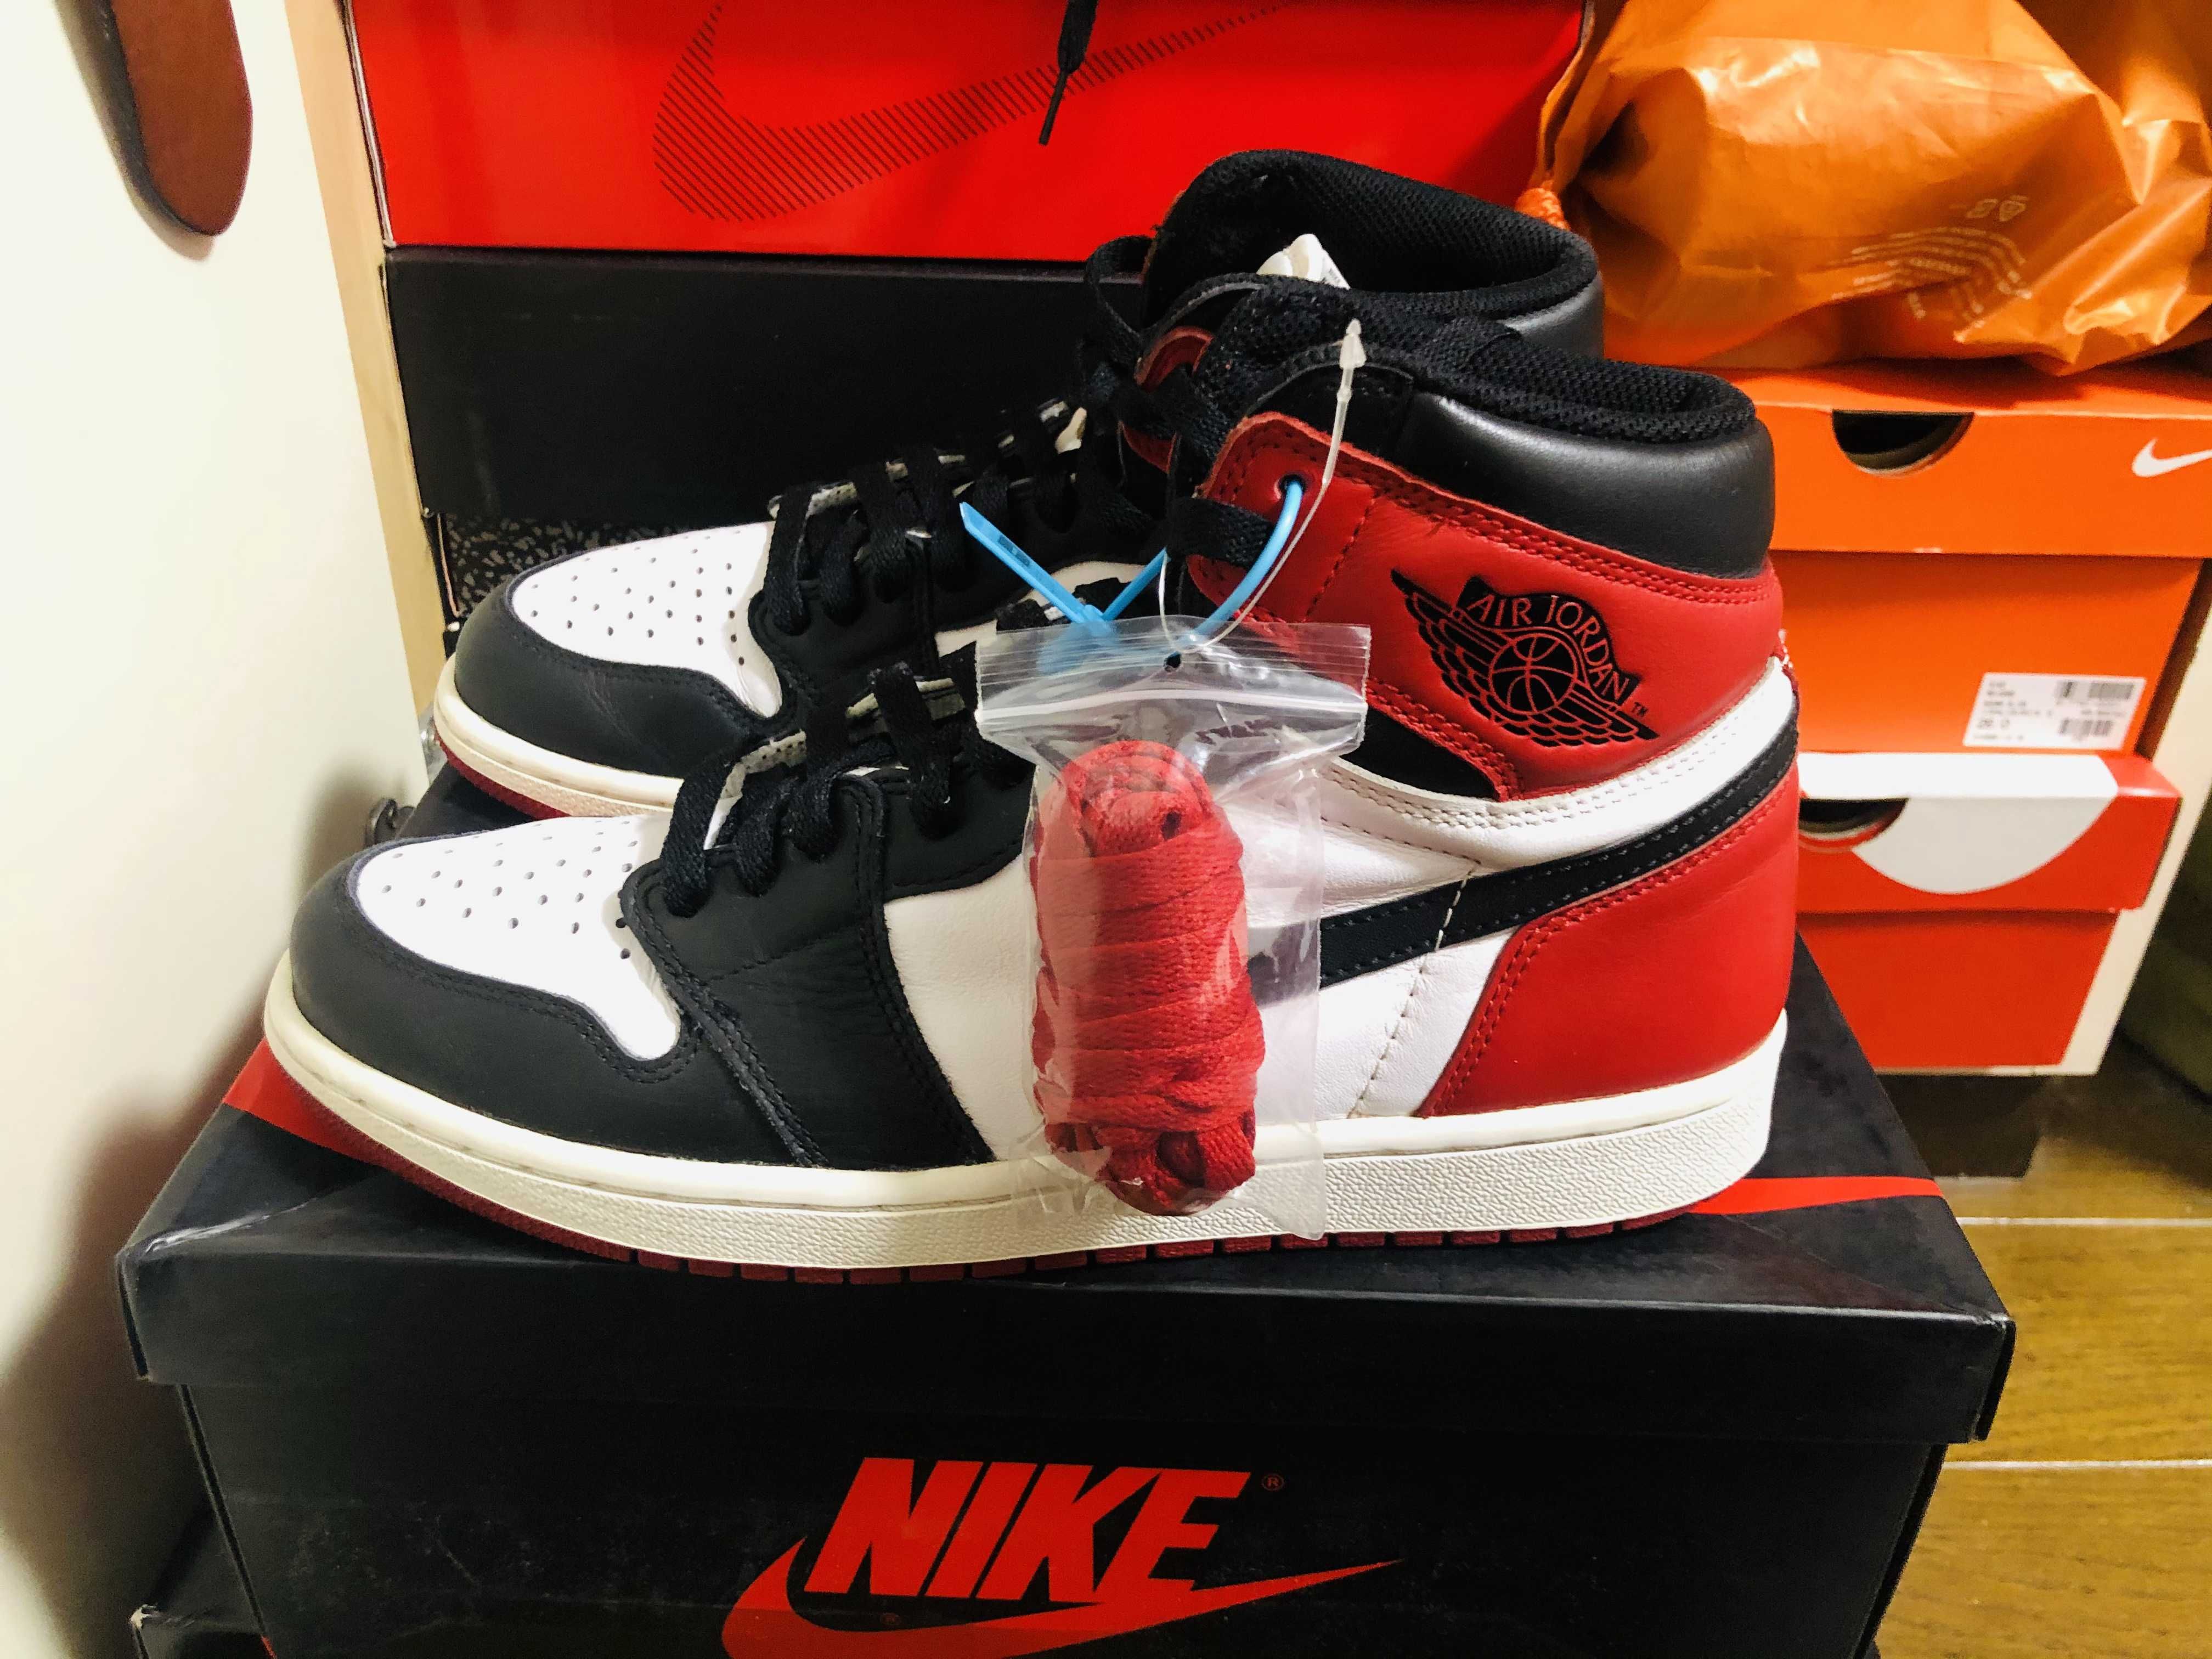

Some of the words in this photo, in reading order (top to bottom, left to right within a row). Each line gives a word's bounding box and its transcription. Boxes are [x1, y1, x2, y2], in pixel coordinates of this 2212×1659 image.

[1465, 593, 1533, 627] AIR
[1544, 594, 1630, 702] JORDAN
[804, 1457, 1251, 1603] NIKE
